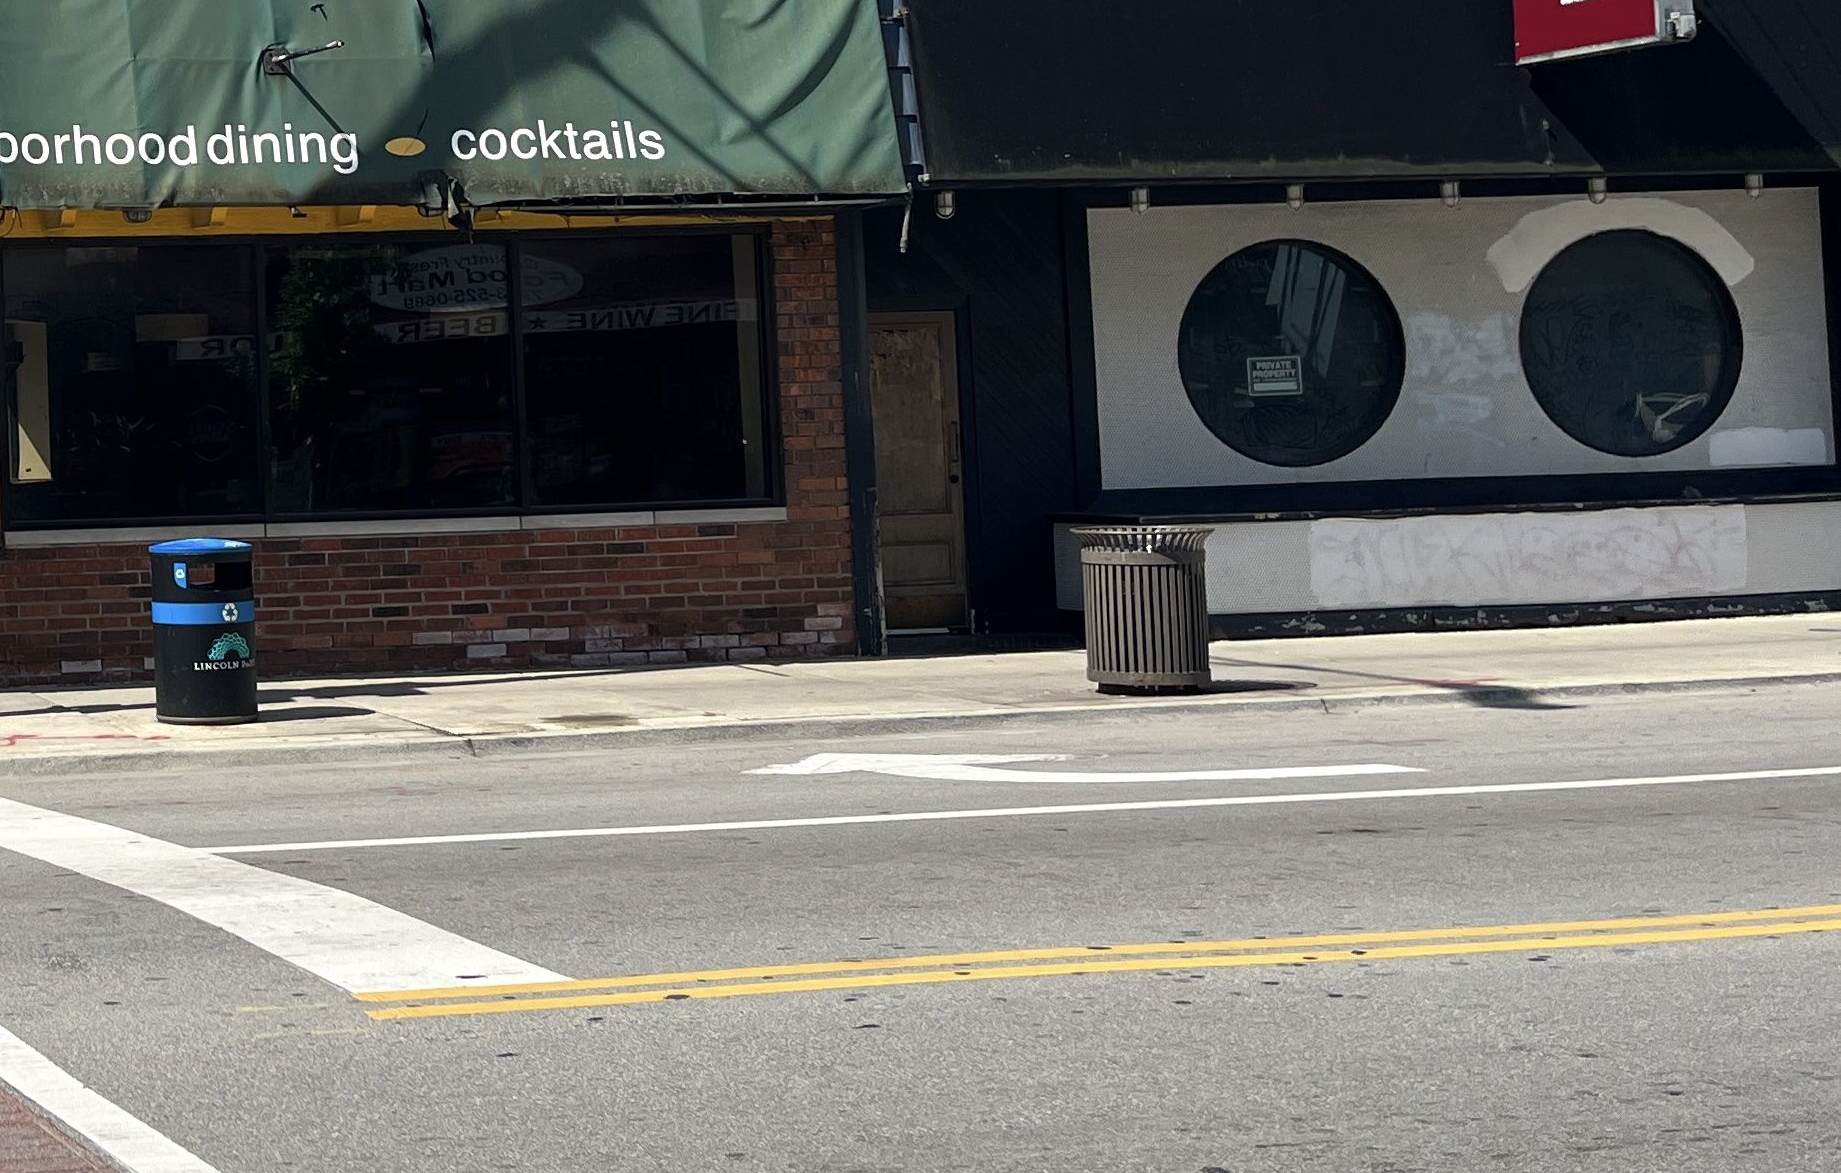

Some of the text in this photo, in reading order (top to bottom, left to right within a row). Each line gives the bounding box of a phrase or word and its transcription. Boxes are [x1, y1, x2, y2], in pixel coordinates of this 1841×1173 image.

[451, 119, 666, 161] cocktails
[207, 123, 359, 175] dining
[1256, 360, 1292, 370] PRIVATE
[1252, 369, 1296, 378] PROPERTY
[193, 660, 239, 671] LINCOLN
